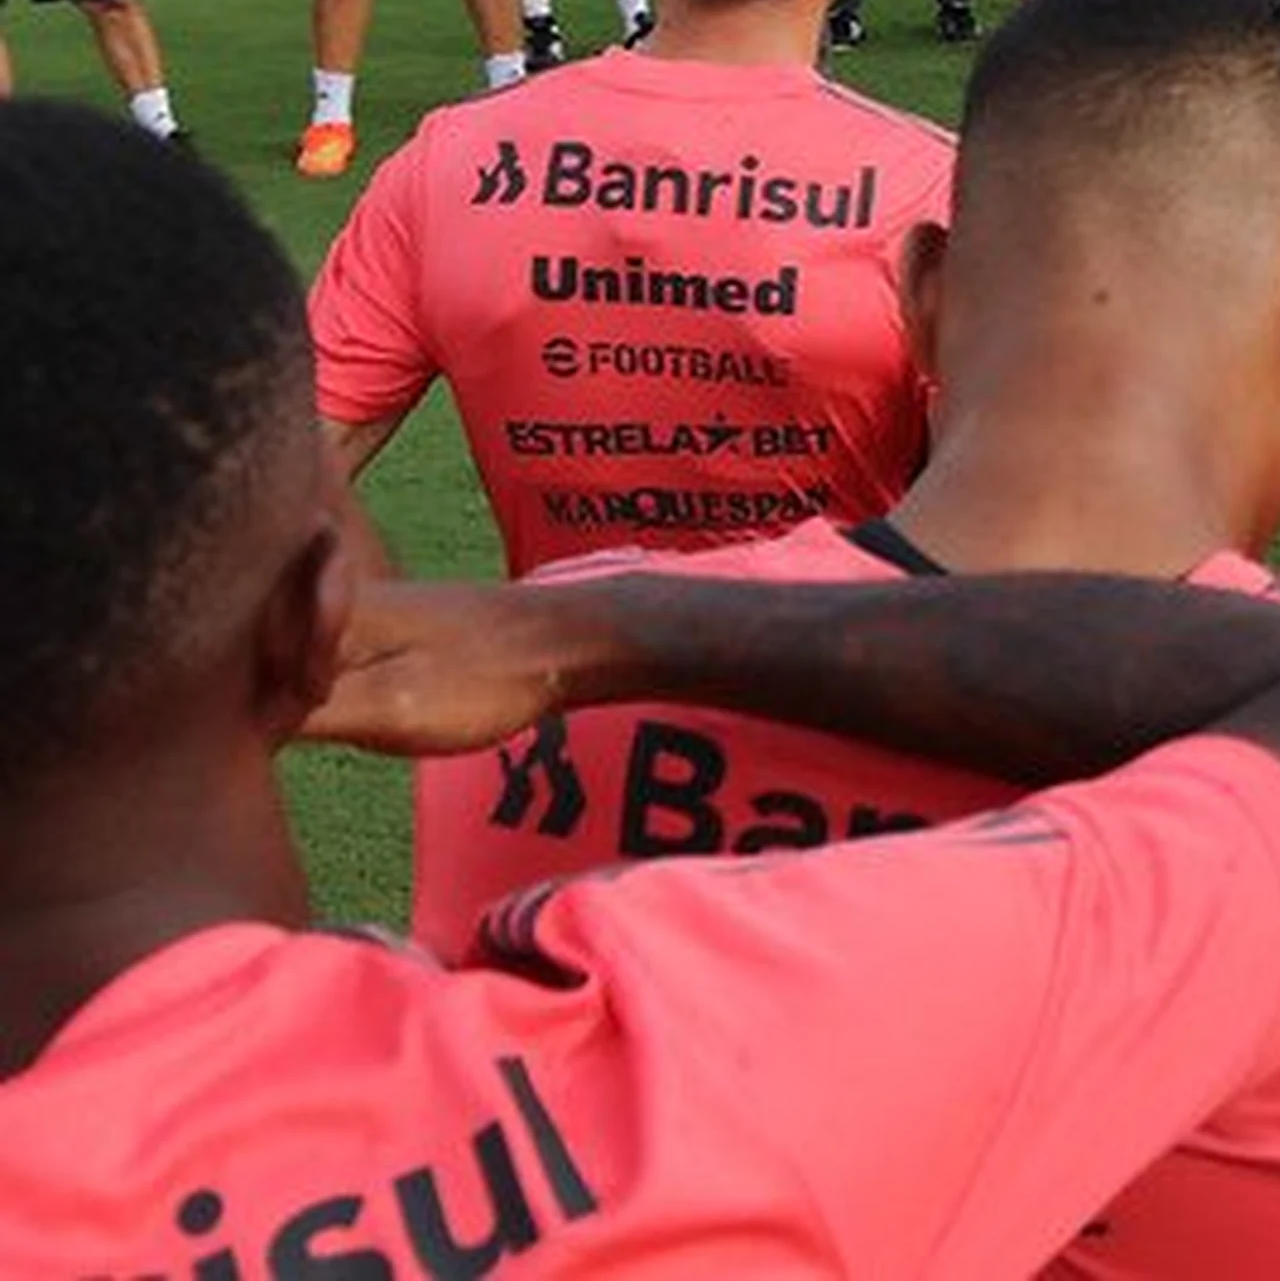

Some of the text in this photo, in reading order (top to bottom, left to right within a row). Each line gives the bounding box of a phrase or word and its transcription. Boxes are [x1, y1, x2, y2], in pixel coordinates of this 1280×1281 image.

[542, 141, 876, 229] Banrisul
[531, 255, 798, 316] Unimed
[506, 420, 702, 456] ESTRELA
[78, 1055, 598, 1281] isul
